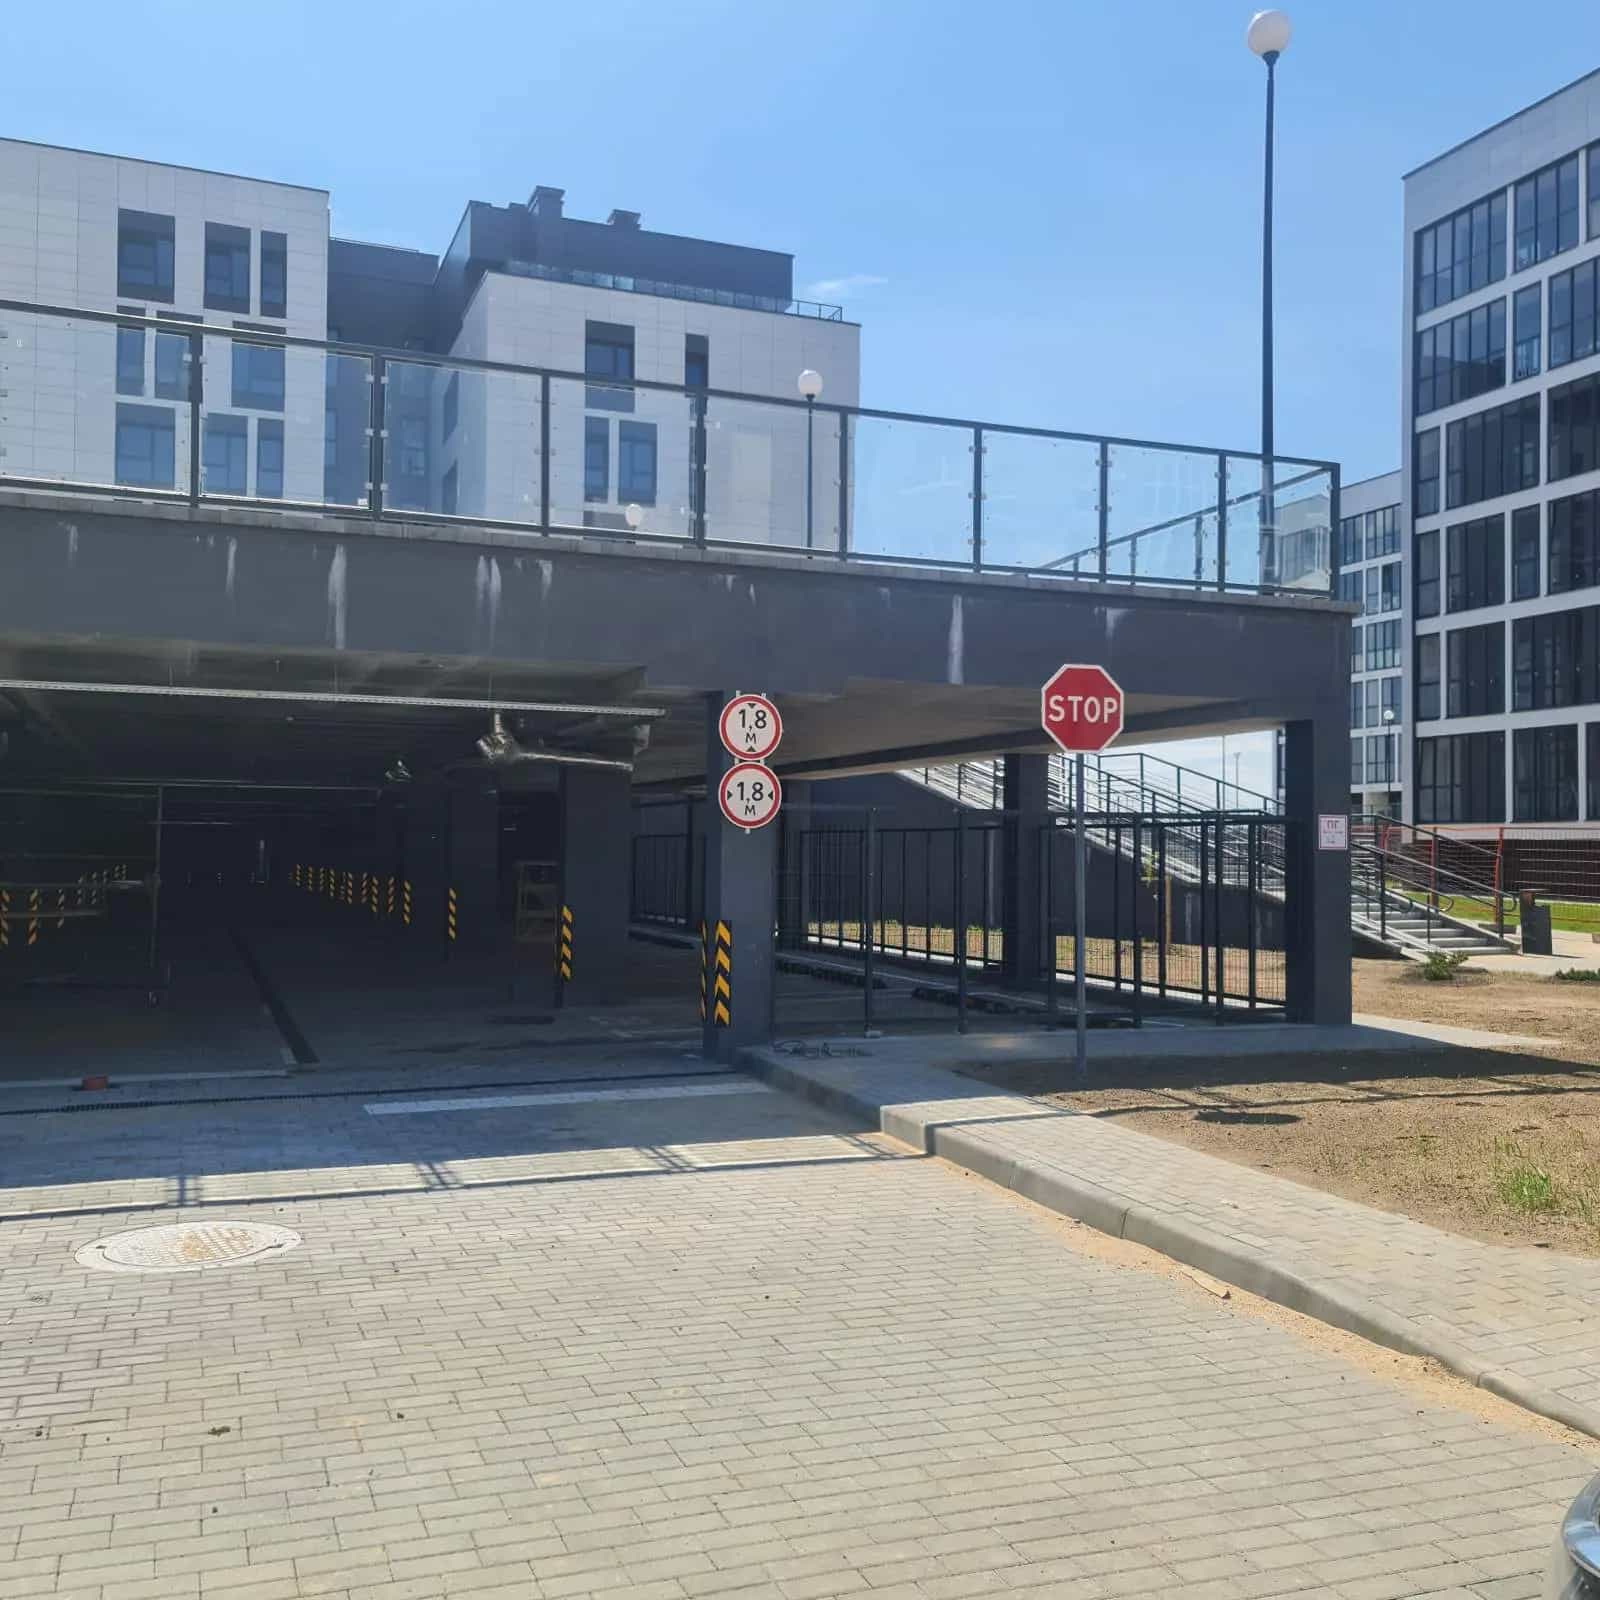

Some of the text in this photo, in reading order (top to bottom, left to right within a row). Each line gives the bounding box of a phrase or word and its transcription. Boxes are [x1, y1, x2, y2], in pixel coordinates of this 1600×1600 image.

[738, 709, 767, 731] 1,8
[1048, 695, 1118, 724] STOP
[737, 781, 764, 804] 1,8
